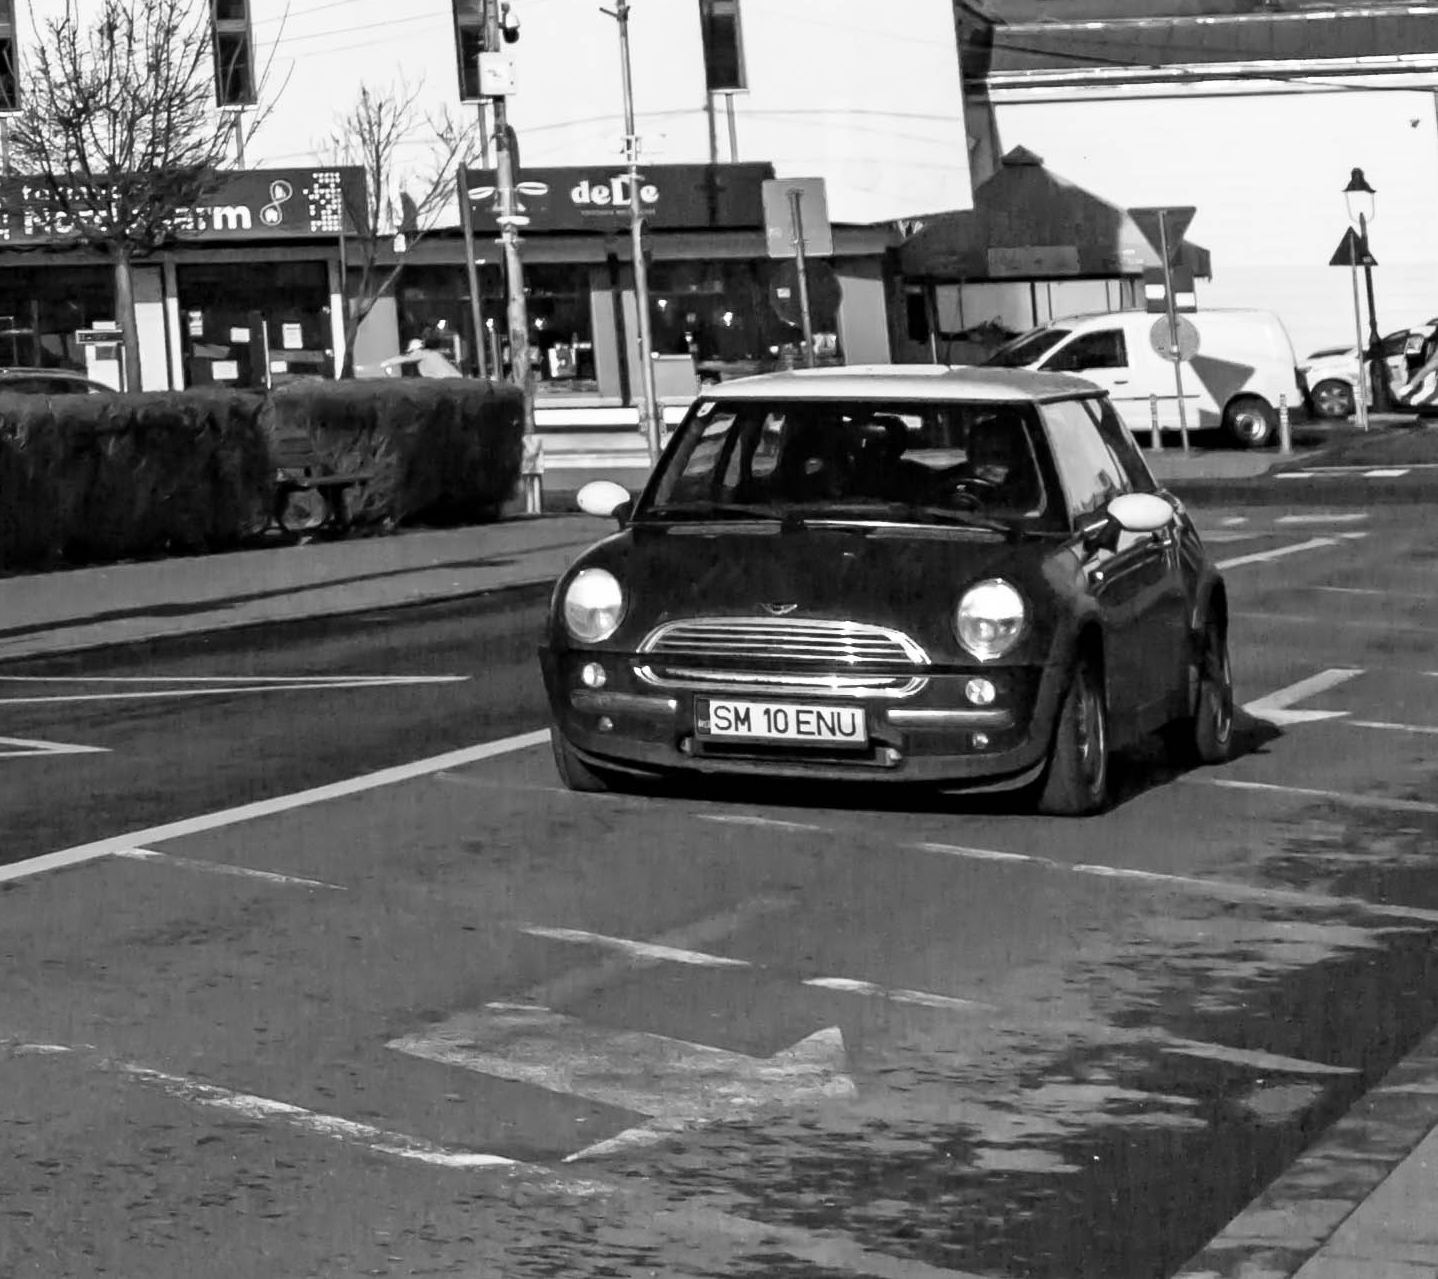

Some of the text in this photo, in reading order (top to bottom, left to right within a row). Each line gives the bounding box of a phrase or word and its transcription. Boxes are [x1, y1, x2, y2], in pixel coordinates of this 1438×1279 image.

[714, 705, 856, 736] SM 10 ENU
